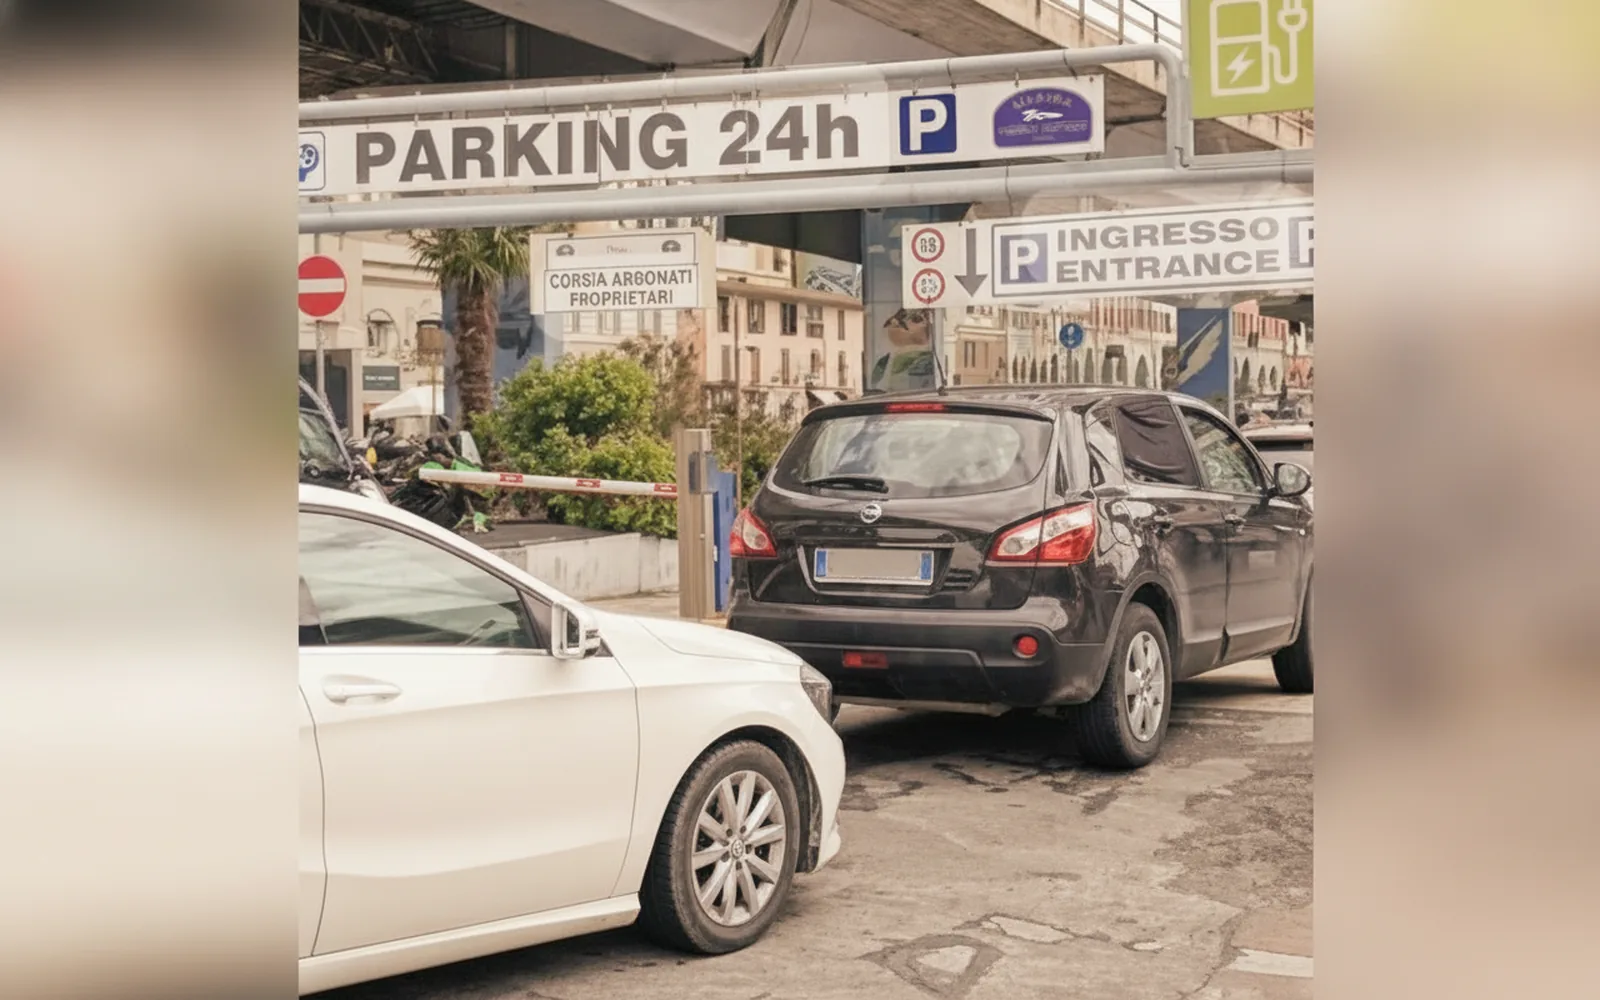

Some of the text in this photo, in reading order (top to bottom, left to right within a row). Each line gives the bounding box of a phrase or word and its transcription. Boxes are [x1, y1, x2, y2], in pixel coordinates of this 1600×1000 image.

[356, 103, 859, 185] PARKING 24h
[909, 98, 947, 151] P
[1057, 217, 1279, 253] INGRESSO
[1009, 238, 1040, 280] P
[1056, 249, 1281, 284] ENTRANCE
[550, 271, 608, 289] CORSIA
